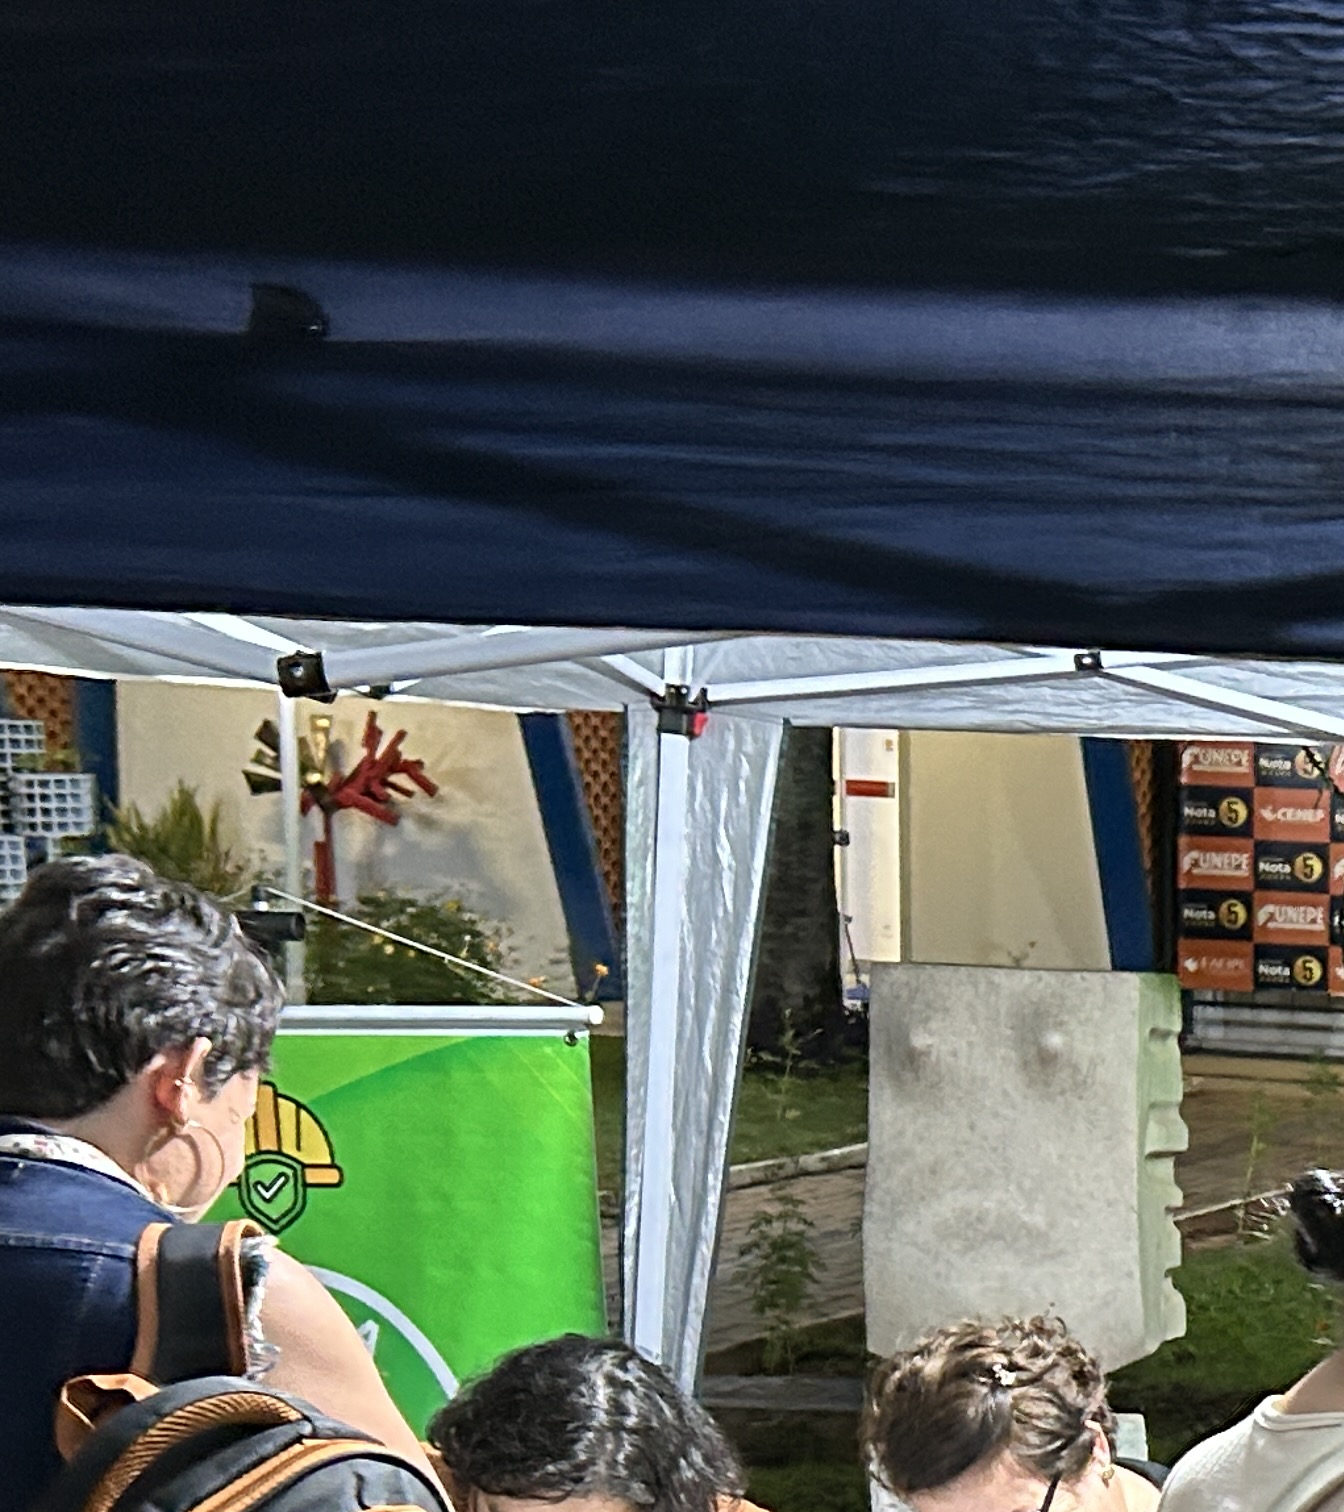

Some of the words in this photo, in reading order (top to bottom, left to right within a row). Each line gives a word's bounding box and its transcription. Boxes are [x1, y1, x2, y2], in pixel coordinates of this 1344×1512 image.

[1183, 806, 1216, 818] Nota
[1226, 800, 1240, 824] 5
[1259, 862, 1291, 874] Nota
[1302, 855, 1315, 879] 5
[1183, 908, 1216, 920] Nota
[1226, 902, 1239, 925] 5
[1258, 964, 1291, 976] Nota
[1302, 959, 1314, 981] 5
